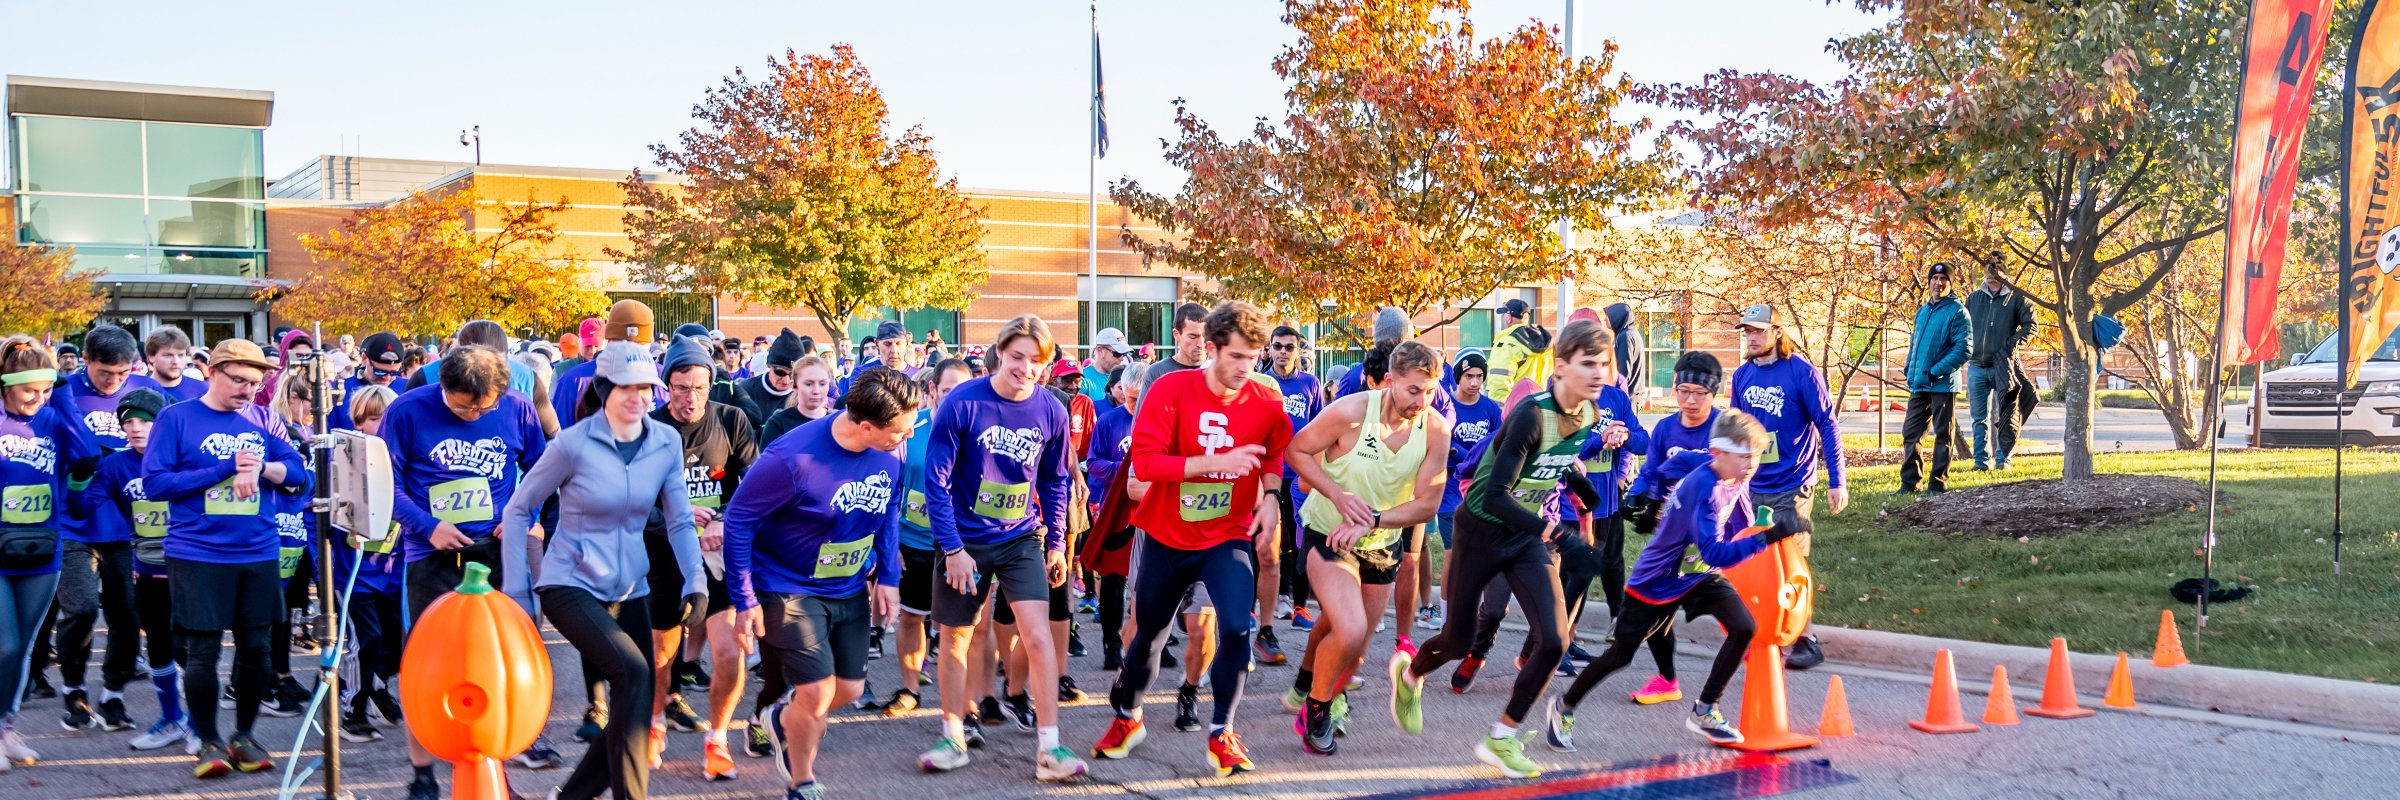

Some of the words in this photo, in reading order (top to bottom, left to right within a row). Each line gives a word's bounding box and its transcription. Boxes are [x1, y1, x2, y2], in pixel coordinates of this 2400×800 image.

[977, 425, 1042, 451] FRIGHTFUL
[429, 438, 508, 466] FRIGHTFUL
[1017, 448, 1041, 467] 5K
[480, 460, 506, 480] 5K
[687, 480, 723, 498] GARA
[830, 481, 892, 512] FRIGHTFUL
[21, 494, 51, 513] 212
[449, 488, 490, 511] 272
[867, 497, 892, 515] 5K
[994, 493, 1027, 509] 389
[1197, 491, 1230, 511] 242
[836, 545, 870, 568] 387
